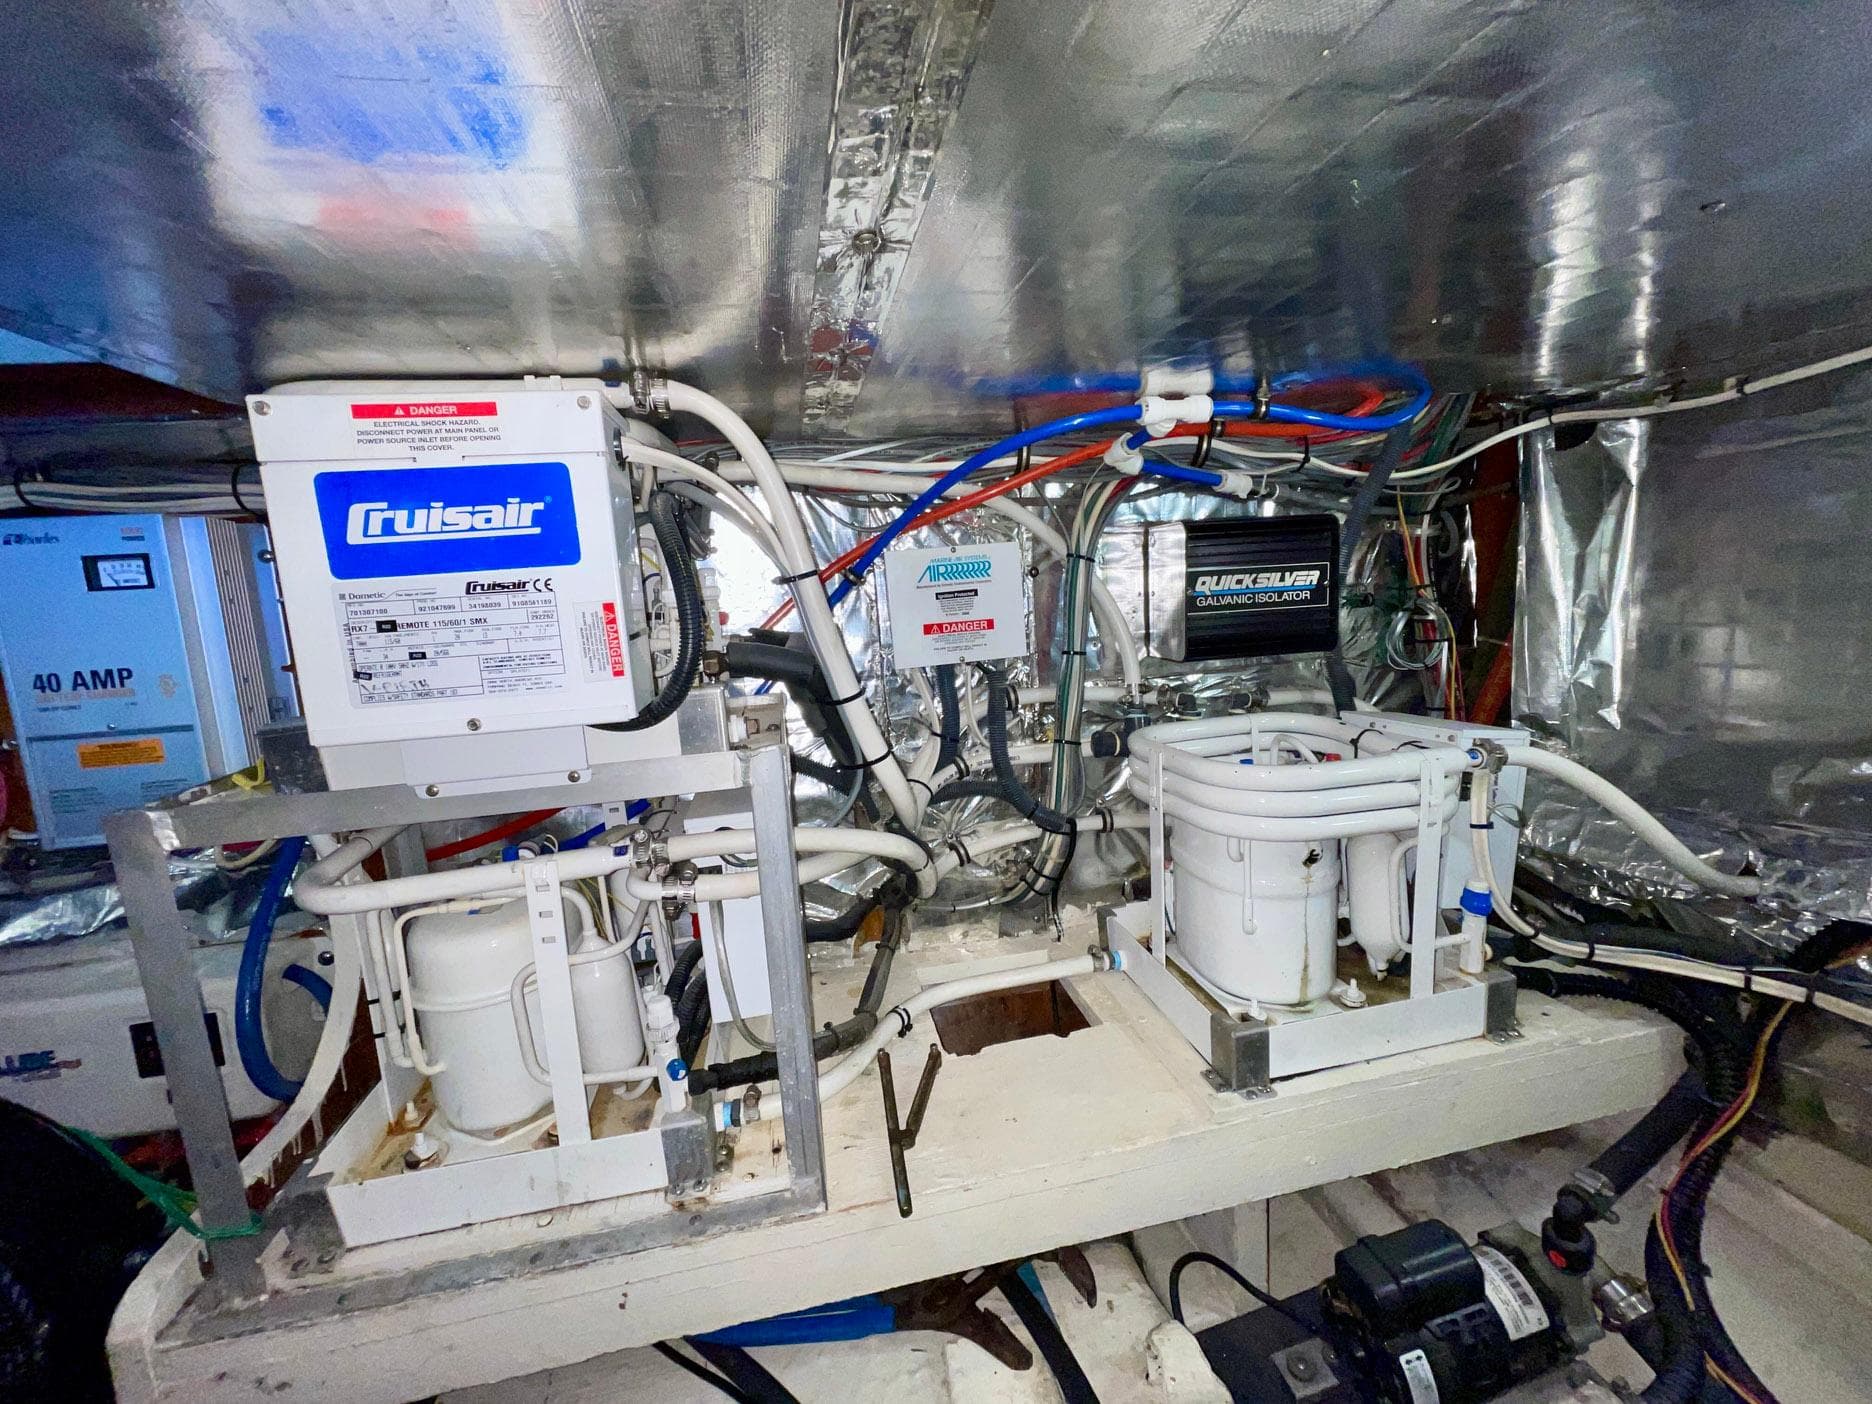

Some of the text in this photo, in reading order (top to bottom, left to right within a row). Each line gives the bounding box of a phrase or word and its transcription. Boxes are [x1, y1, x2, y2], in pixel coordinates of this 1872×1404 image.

[409, 405, 458, 415] DANGER
[373, 419, 420, 427] ELECTRICAL
[449, 418, 481, 426] HAZARD.
[356, 429, 405, 437] DISCONNECT
[357, 437, 385, 445] POWER
[469, 434, 501, 442] OPENING
[427, 444, 455, 452] COVER.
[346, 497, 545, 545] Cruisair
[465, 580, 530, 595] Cruisair
[1194, 570, 1320, 595] QUICKSILVER
[348, 591, 387, 600] Dometic
[1196, 591, 1311, 607] GALVANIC ISOLATOR
[397, 621, 430, 630] REMOTE
[469, 617, 488, 625] SMX
[942, 620, 988, 632] DANGER
[606, 624, 624, 672] DANGER
[33, 667, 134, 693] 40 AMP
